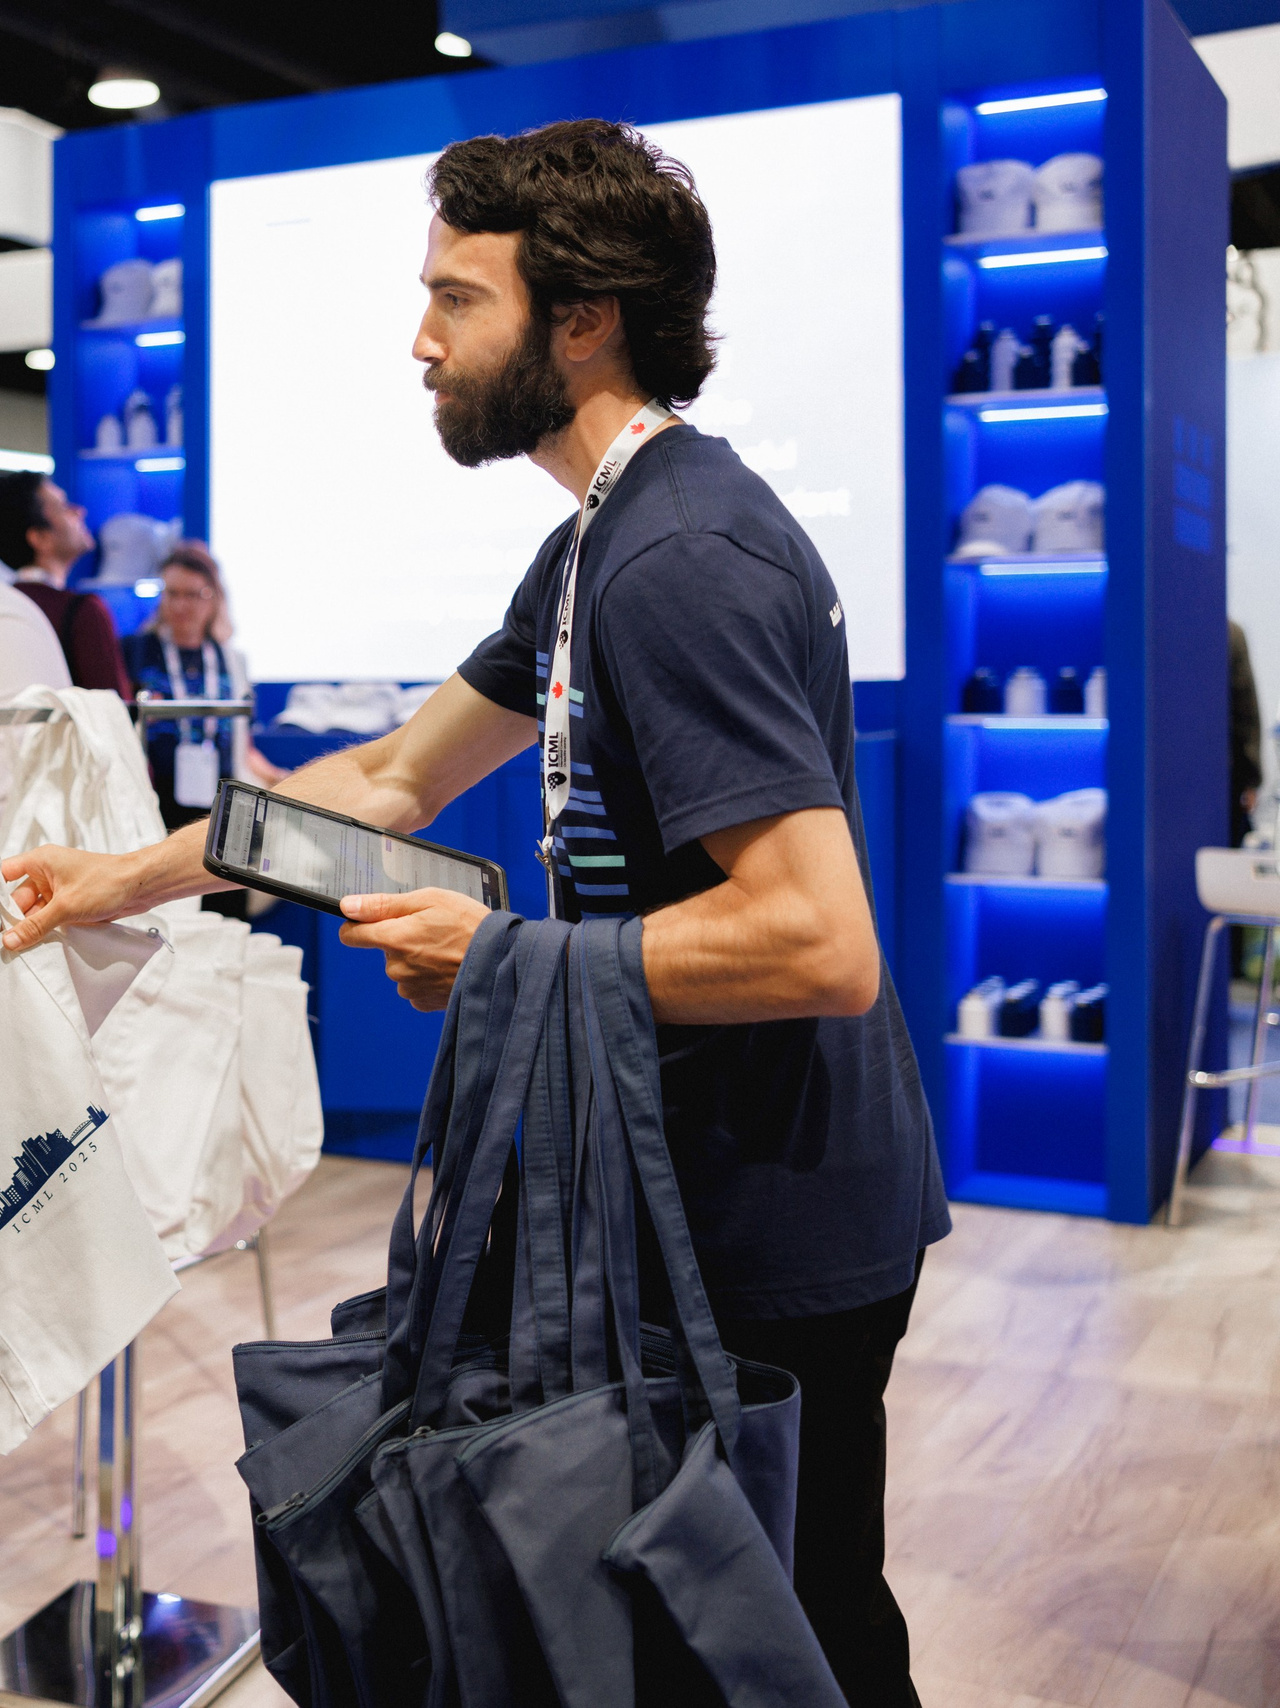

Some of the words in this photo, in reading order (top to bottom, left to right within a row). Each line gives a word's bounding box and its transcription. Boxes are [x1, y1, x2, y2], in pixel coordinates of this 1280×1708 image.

[593, 460, 617, 492] ICML
[548, 731, 559, 768] ICML
[12, 1190, 54, 1233] ICML
[58, 1141, 98, 1183] 2025
